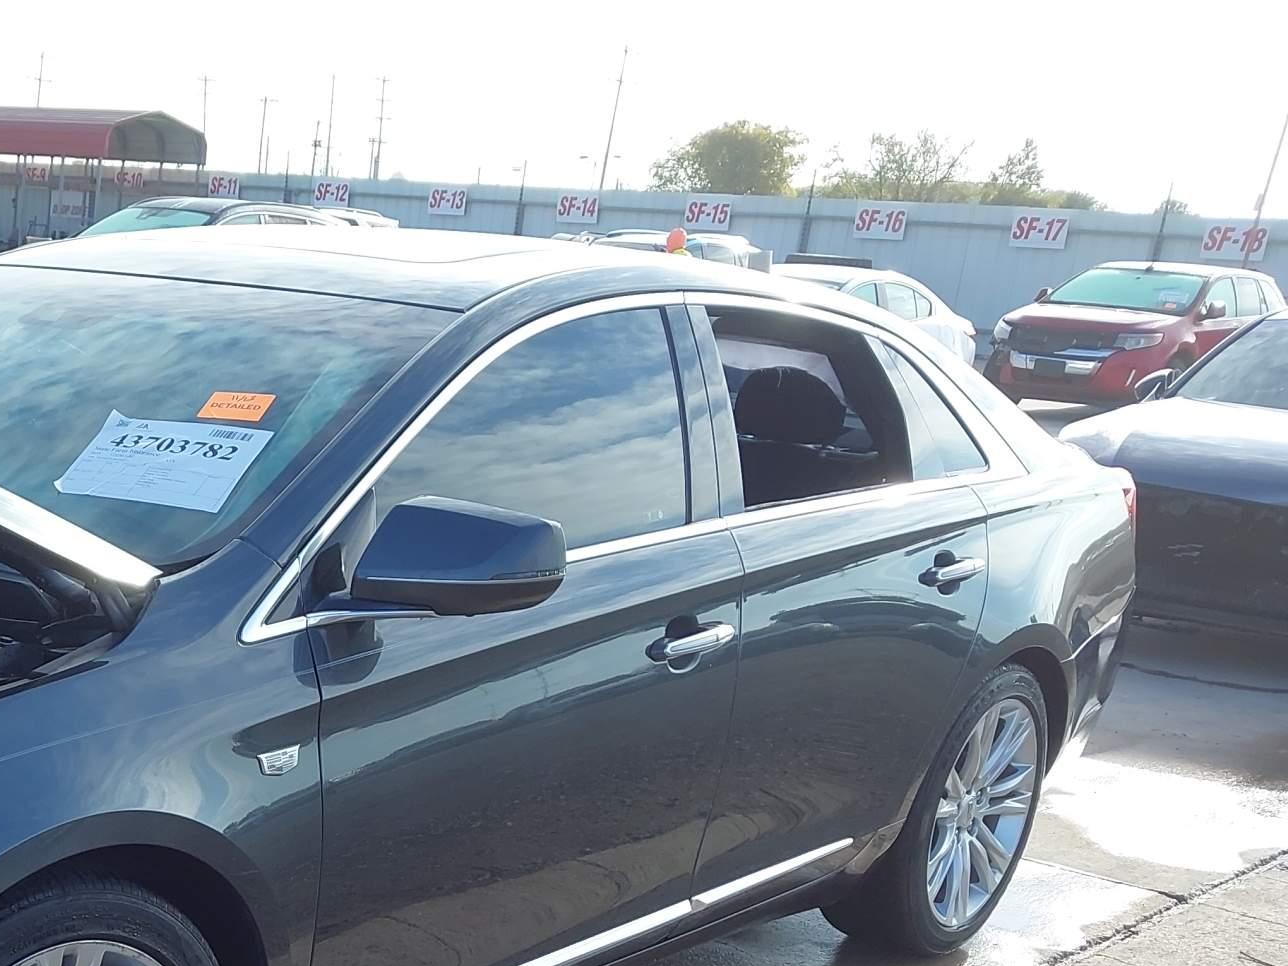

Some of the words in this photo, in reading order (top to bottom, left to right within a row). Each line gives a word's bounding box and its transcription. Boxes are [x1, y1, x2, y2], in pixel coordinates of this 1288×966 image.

[209, 177, 238, 195] SF-11
[315, 182, 349, 202] SF-12
[429, 189, 466, 210] SF-13
[557, 196, 598, 218] SF-14
[685, 201, 729, 225] SF-15
[855, 208, 906, 233] SF-16
[1012, 215, 1067, 241] SF-17
[1203, 225, 1267, 253] SF-18
[210, 402, 262, 411] DETAILED
[110, 433, 239, 461] 43703782
